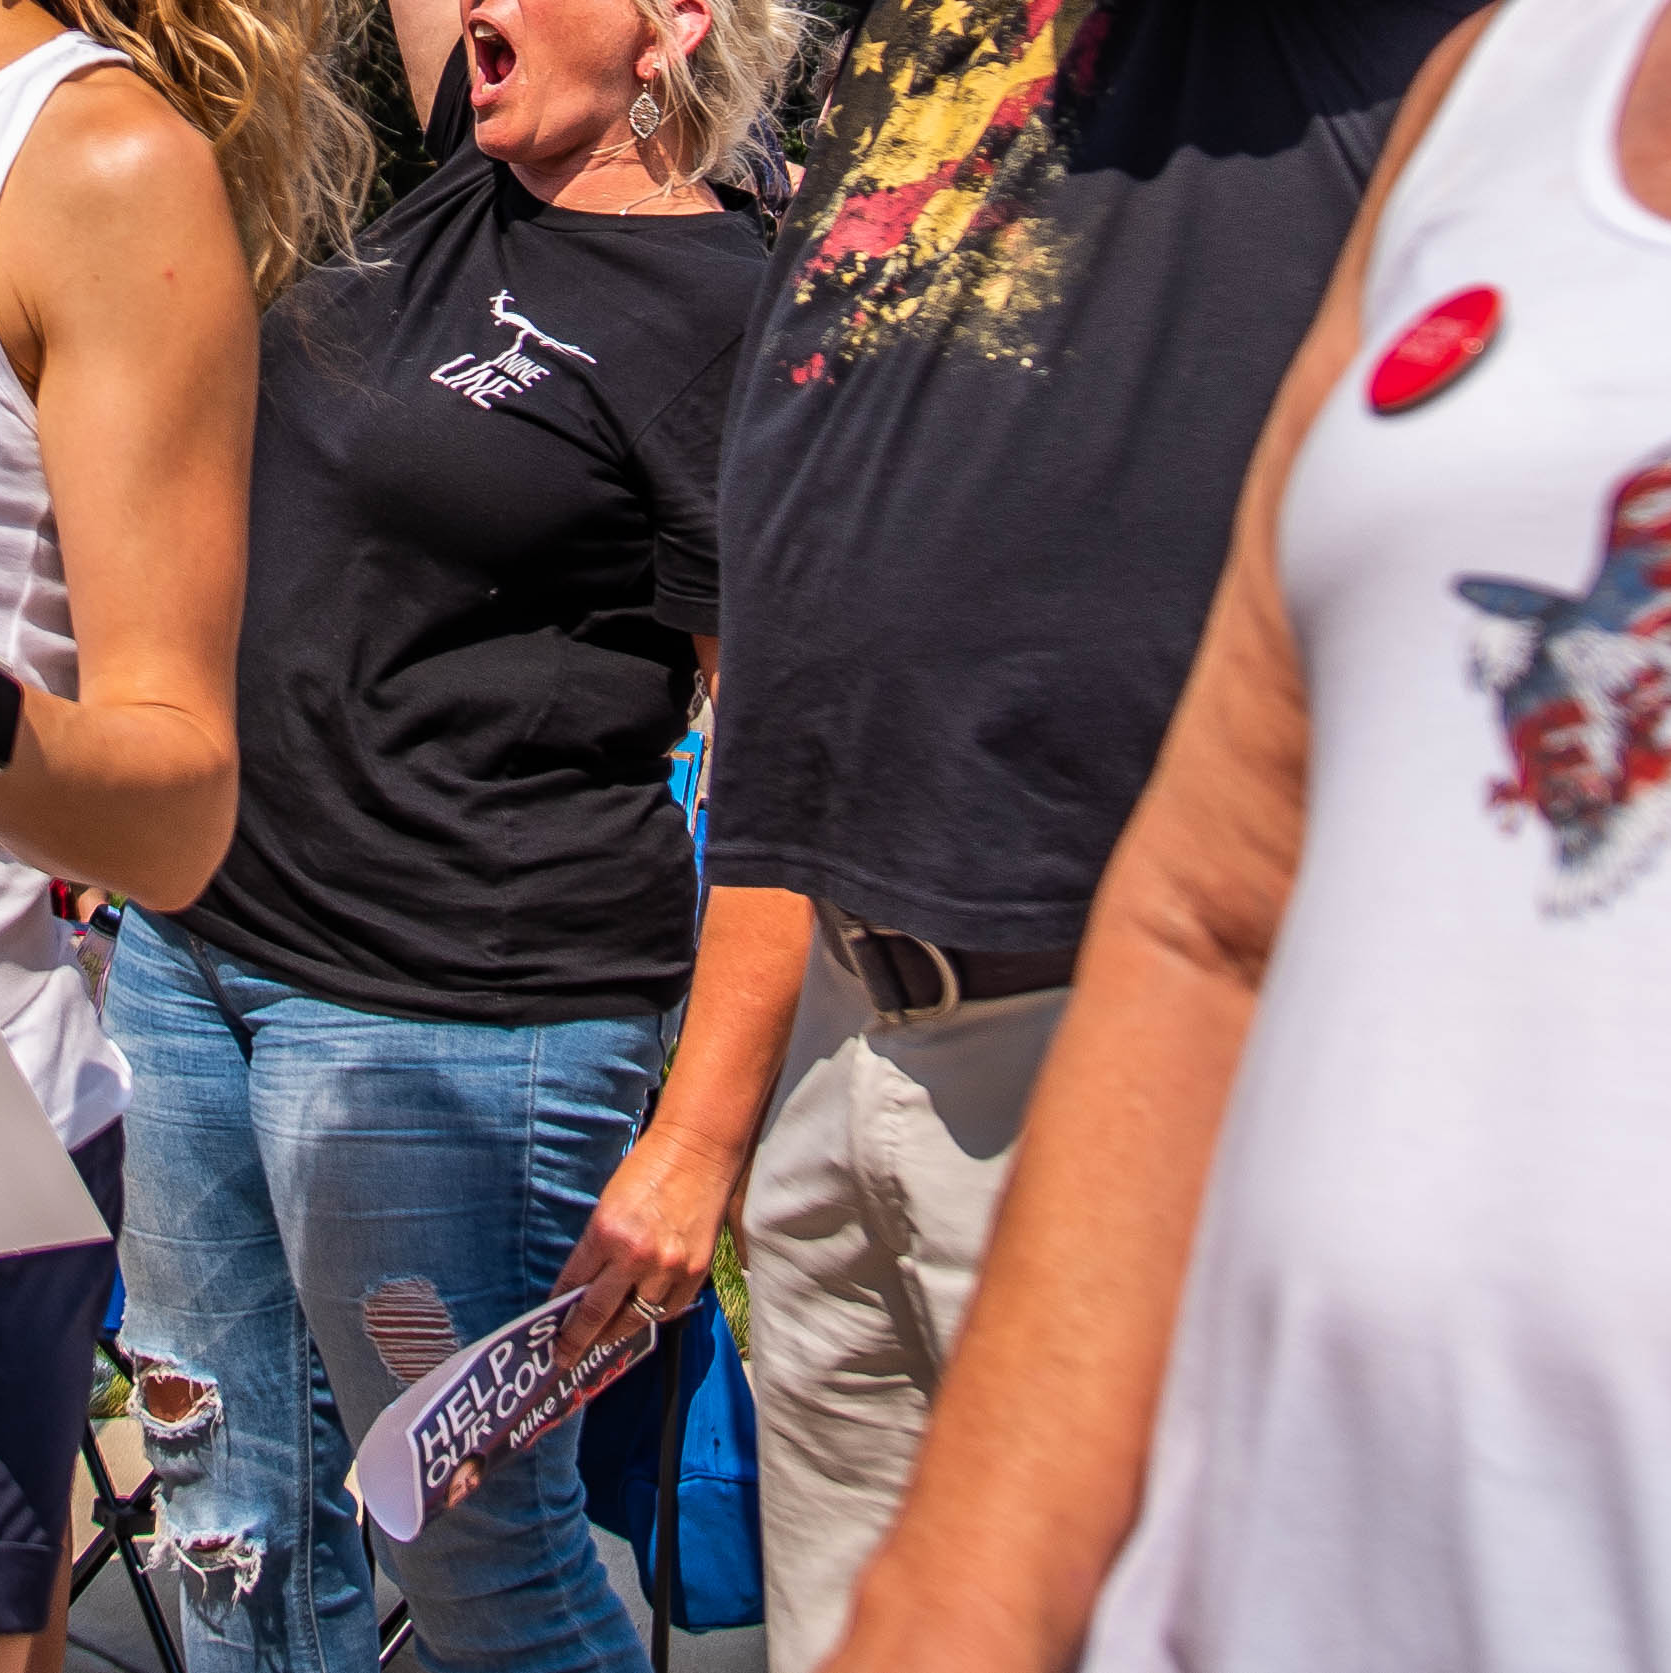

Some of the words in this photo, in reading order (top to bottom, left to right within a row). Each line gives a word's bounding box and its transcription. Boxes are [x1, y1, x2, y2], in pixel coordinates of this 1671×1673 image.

[429, 352, 524, 410] LINE
[420, 1339, 515, 1463] HELP
[509, 1394, 557, 1449] Mike
[426, 1409, 495, 1489] OUR
